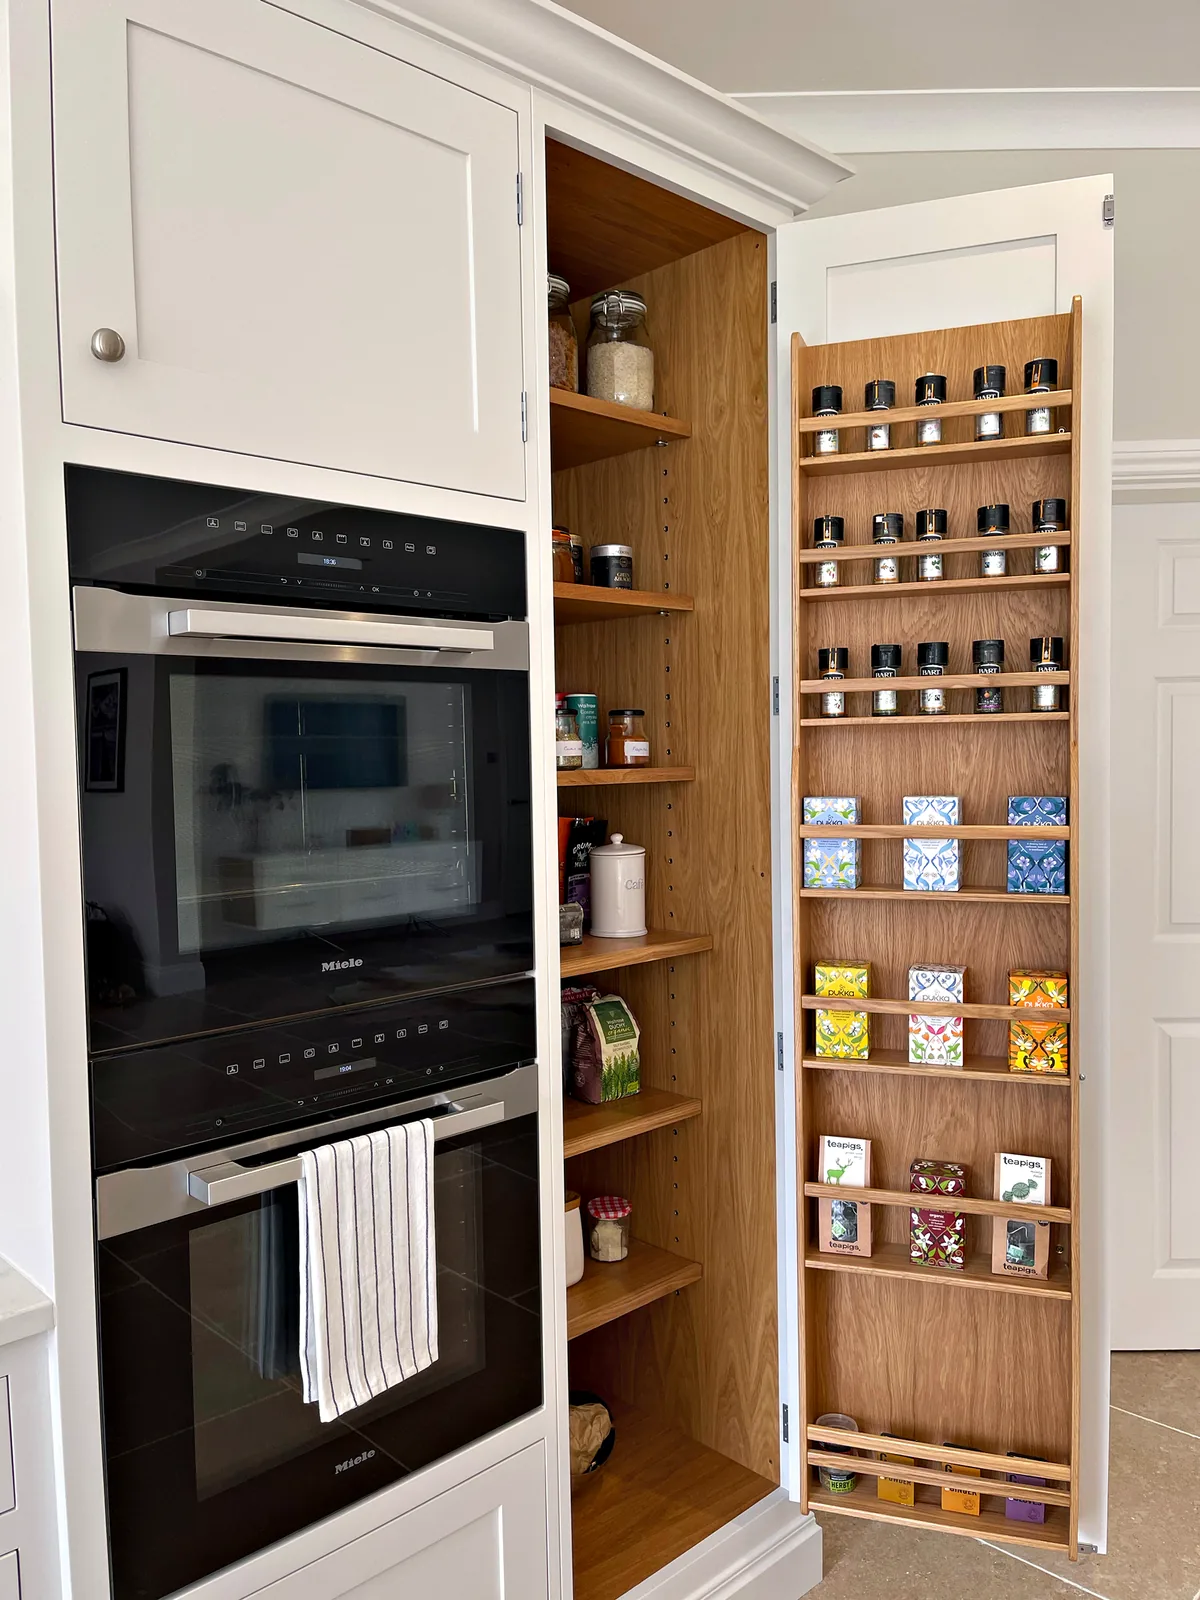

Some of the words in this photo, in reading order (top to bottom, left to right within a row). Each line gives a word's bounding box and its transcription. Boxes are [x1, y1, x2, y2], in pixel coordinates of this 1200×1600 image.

[817, 429, 837, 437] NUTMEG
[978, 667, 998, 675] BART
[321, 958, 363, 972] Miele
[828, 989, 855, 998] pukka
[922, 994, 951, 1003] pukka
[1024, 1001, 1054, 1009] pukka
[339, 1064, 352, 1072] 19:04
[827, 1139, 864, 1152] teapigs.
[1002, 1155, 1043, 1171] teapigs.
[829, 1240, 862, 1252] teapigs.
[1003, 1262, 1039, 1277] teapigs.
[831, 1481, 850, 1489] HERBY
